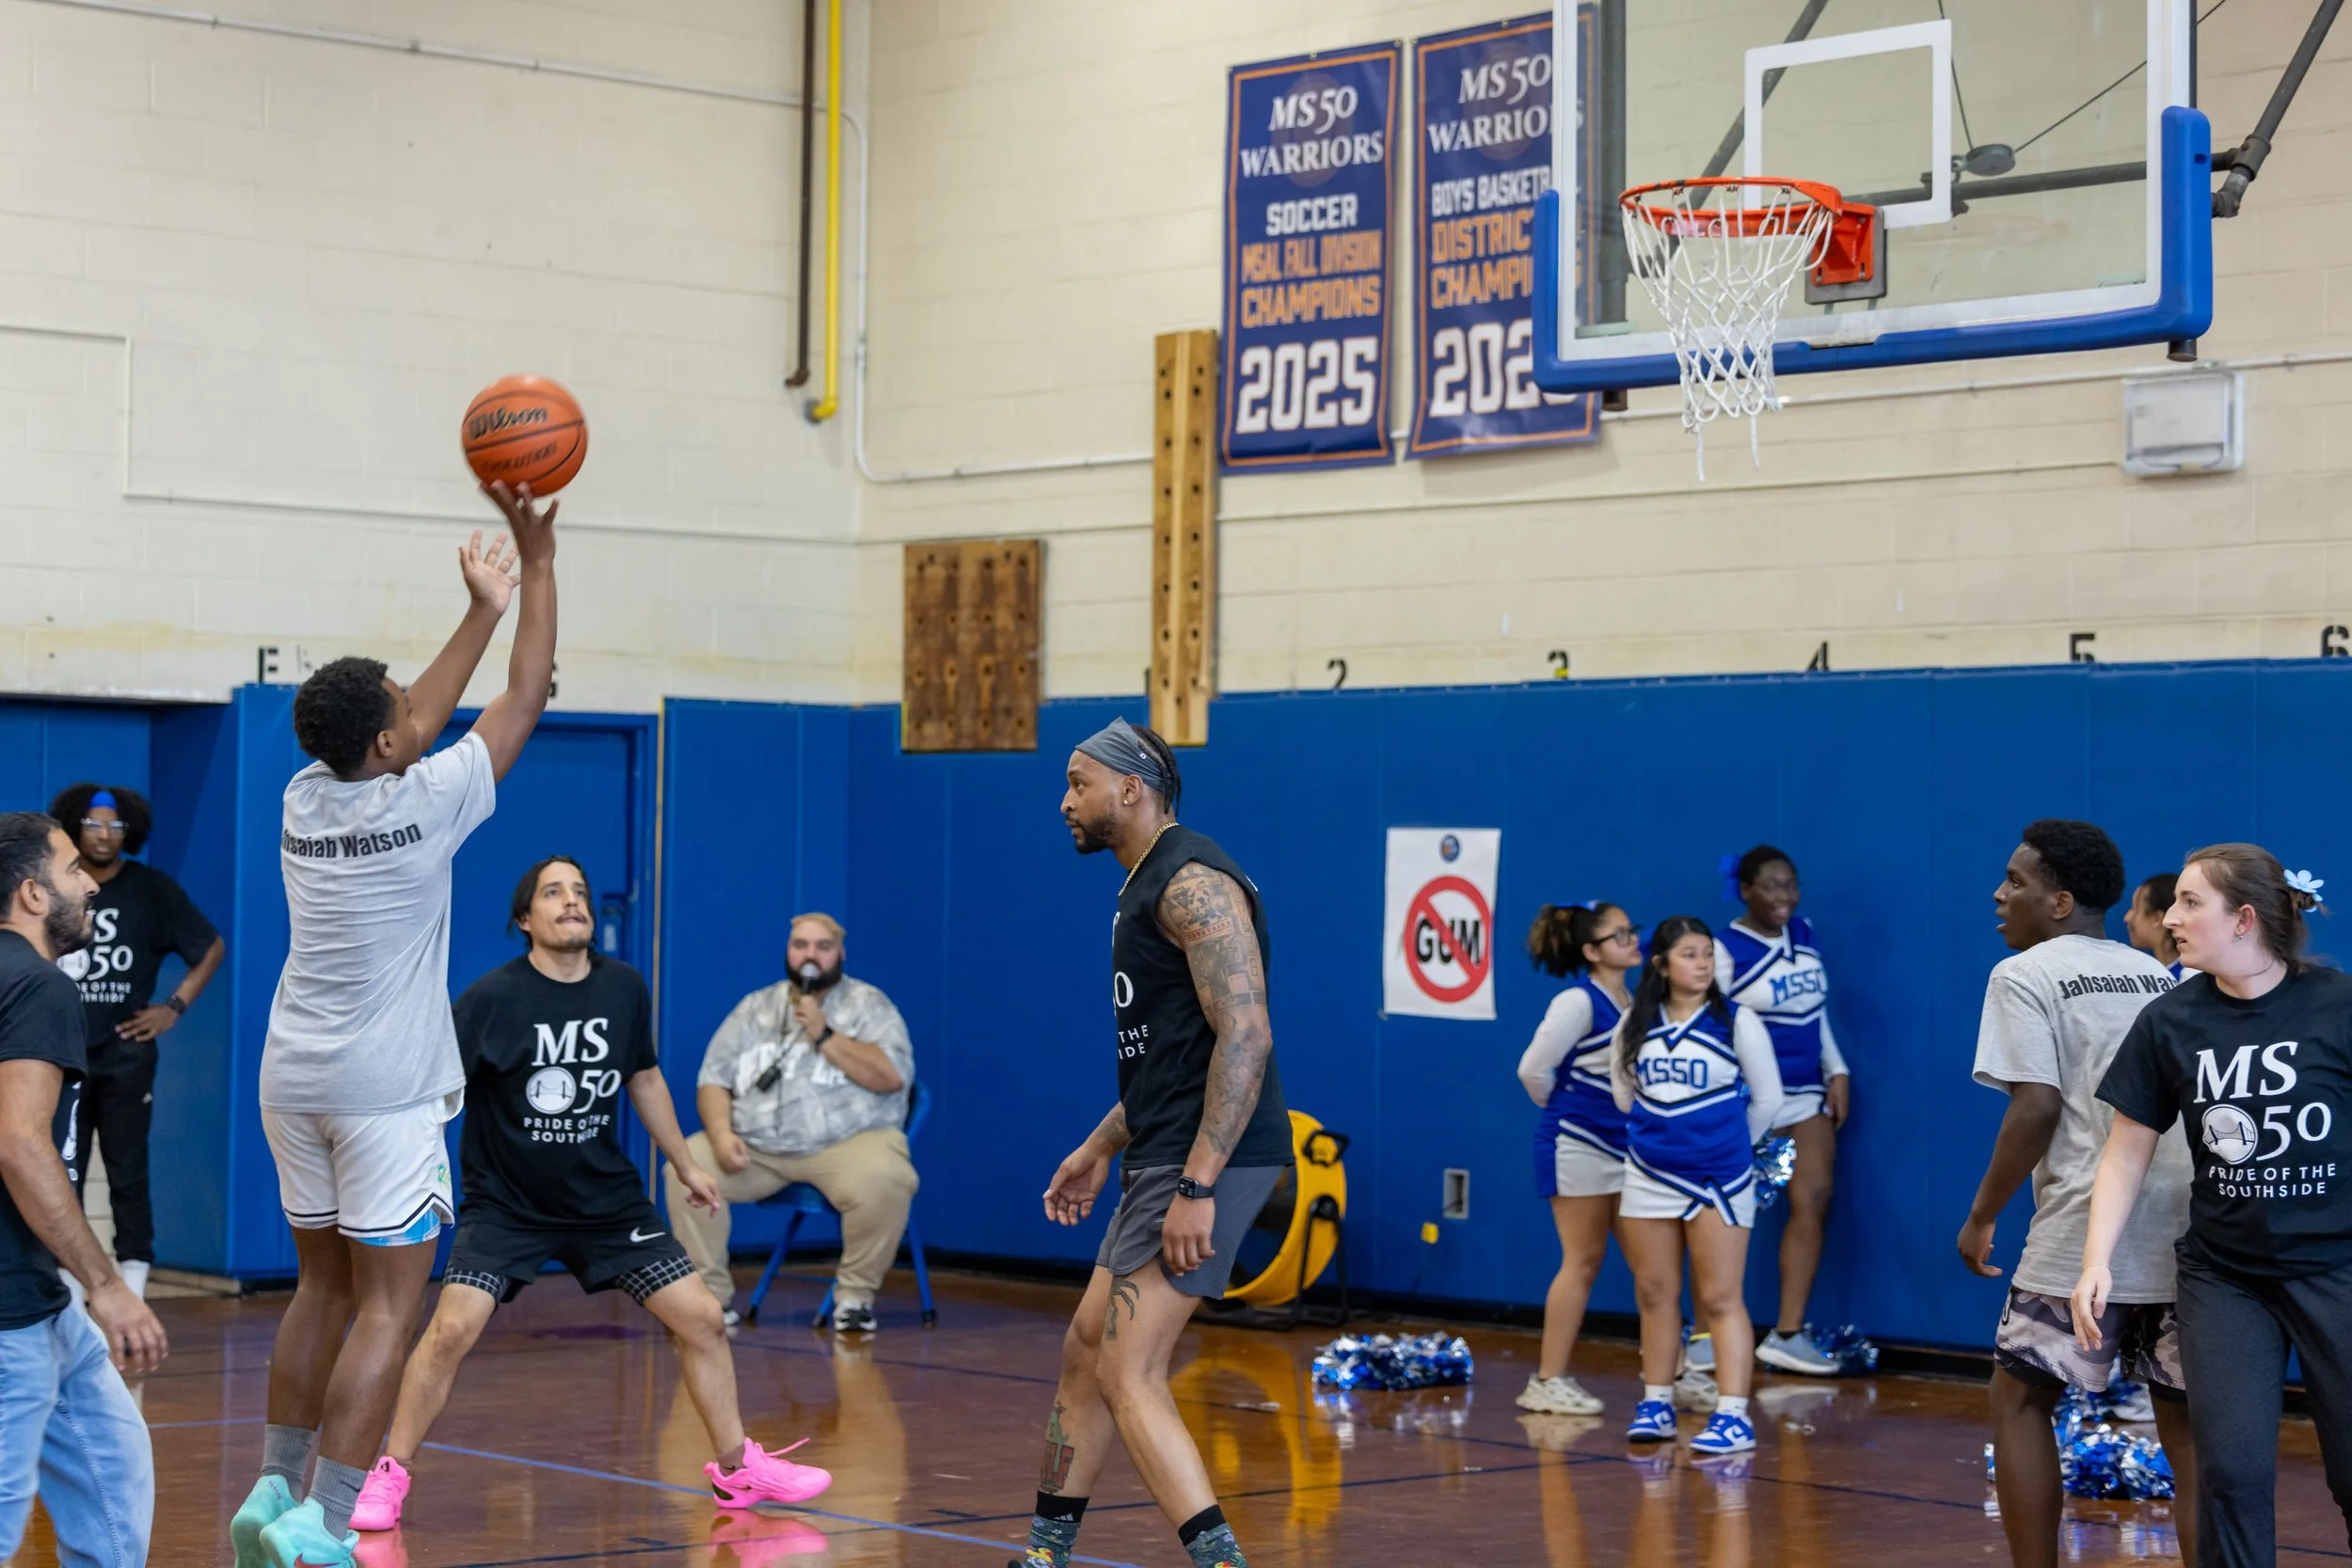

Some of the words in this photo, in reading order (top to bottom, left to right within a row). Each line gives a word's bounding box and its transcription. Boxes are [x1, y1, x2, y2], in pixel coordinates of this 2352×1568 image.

[1240, 130, 1384, 179] WARRIORS
[1265, 193, 1358, 236] SOCCER
[1431, 178, 1475, 217] BOYS
[1431, 210, 1534, 263] DISTRIC
[1240, 274, 1381, 328] CHAMPIONS
[1431, 255, 1533, 309] CHAMPI
[1235, 336, 1379, 435] 2025
[1429, 318, 1579, 418] 202
[469, 405, 549, 441] Wilson
[2070, 633, 2095, 663] 5
[339, 823, 422, 858] Watson
[86, 908, 119, 943] S
[1415, 917, 1482, 966] GUM
[87, 945, 134, 981] 50
[2058, 974, 2140, 1000] Jahsaiah
[531, 1017, 610, 1067] MS
[1119, 1024, 1149, 1043] THE
[572, 1069, 622, 1114] 50
[2193, 1040, 2298, 1103] MS
[523, 1117, 573, 1131] PRIDE
[2256, 1101, 2331, 1161] 50
[2209, 1165, 2256, 1181] PRIDE
[2264, 1167, 2290, 1180] OF
[2299, 1163, 2336, 1180] THE
[2218, 1181, 2326, 1197] SOUTHSIDE
